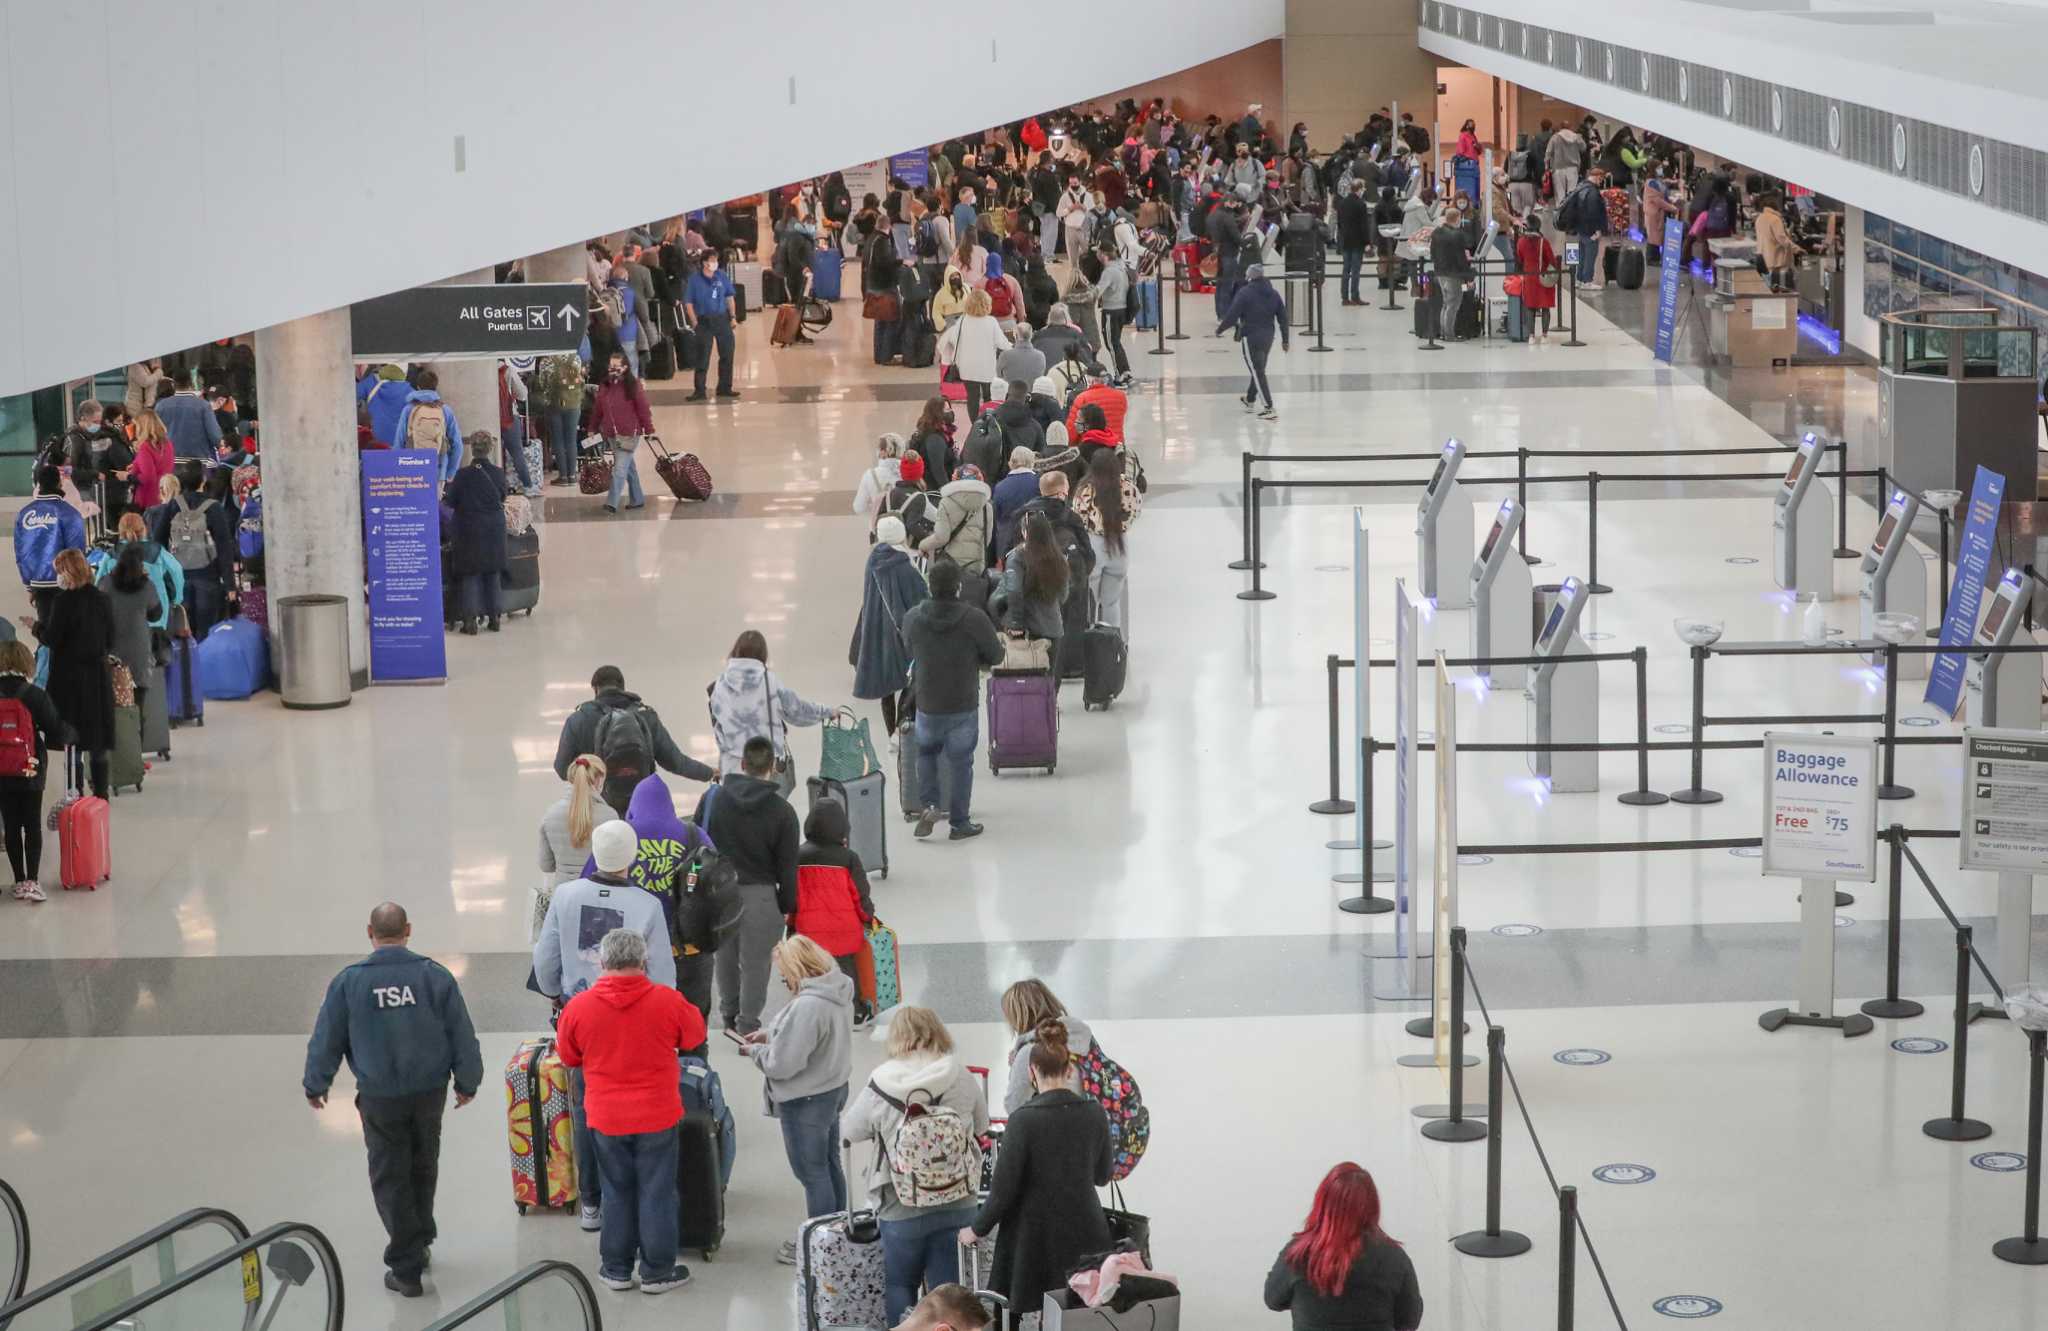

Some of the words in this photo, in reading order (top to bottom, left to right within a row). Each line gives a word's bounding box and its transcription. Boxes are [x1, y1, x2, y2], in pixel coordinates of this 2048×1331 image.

[459, 306, 480, 319] All
[483, 306, 523, 319] Gates
[487, 322, 524, 332] Puertas
[1776, 749, 1847, 770] Baggage
[1775, 767, 1859, 787] Allowance
[1775, 813, 1809, 828] Free
[1824, 815, 1849, 831] $75
[648, 856, 674, 875] THE
[630, 864, 677, 892] PLANE
[372, 985, 417, 1009] TSA
